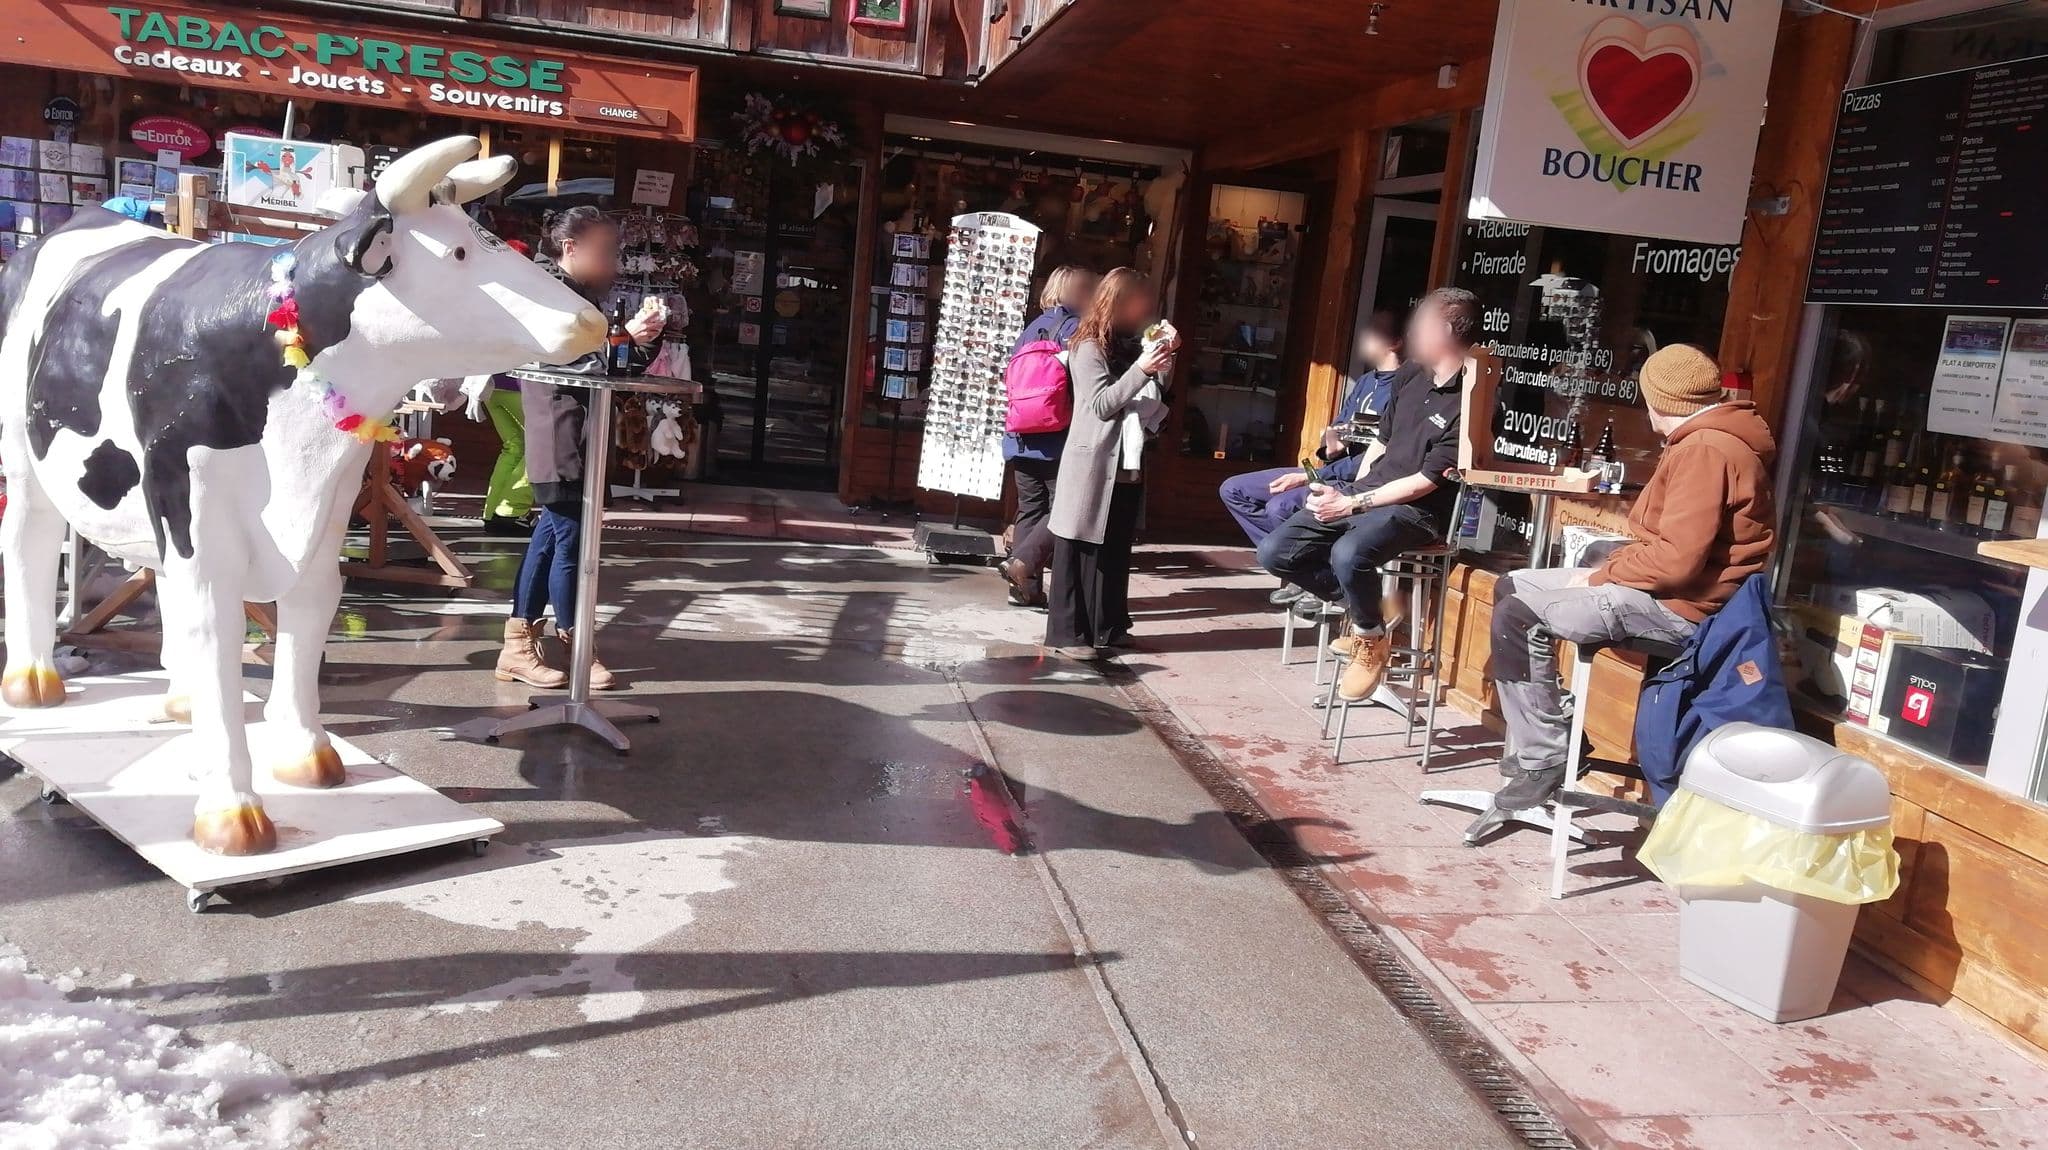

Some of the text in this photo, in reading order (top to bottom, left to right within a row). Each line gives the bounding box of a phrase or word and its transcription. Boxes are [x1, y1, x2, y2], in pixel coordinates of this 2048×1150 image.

[108, 7, 566, 92] TABAC-PRESSE
[114, 45, 242, 78] Cadeaux
[287, 65, 385, 94] Jouets
[429, 83, 563, 116] Souvenirs
[599, 107, 638, 120] CHANGE
[1843, 92, 1882, 112] Pizzas
[147, 129, 193, 147] EDITOR
[1542, 147, 1703, 193] BOUCHER
[1471, 250, 1527, 275] Pierrade
[1631, 242, 1741, 282] Fromages
[1481, 304, 1510, 332] ette
[1488, 339, 1538, 361] Charcuterie
[1540, 344, 1547, 361] à
[1505, 366, 1560, 389] Charcuterie
[1570, 377, 1600, 397] partir
[1601, 379, 1616, 397] de
[1618, 379, 1639, 404] 8€)
[1500, 401, 1572, 442] avoyard
[1494, 436, 1557, 466] Charcuterie à
[1494, 474, 1513, 484] BON
